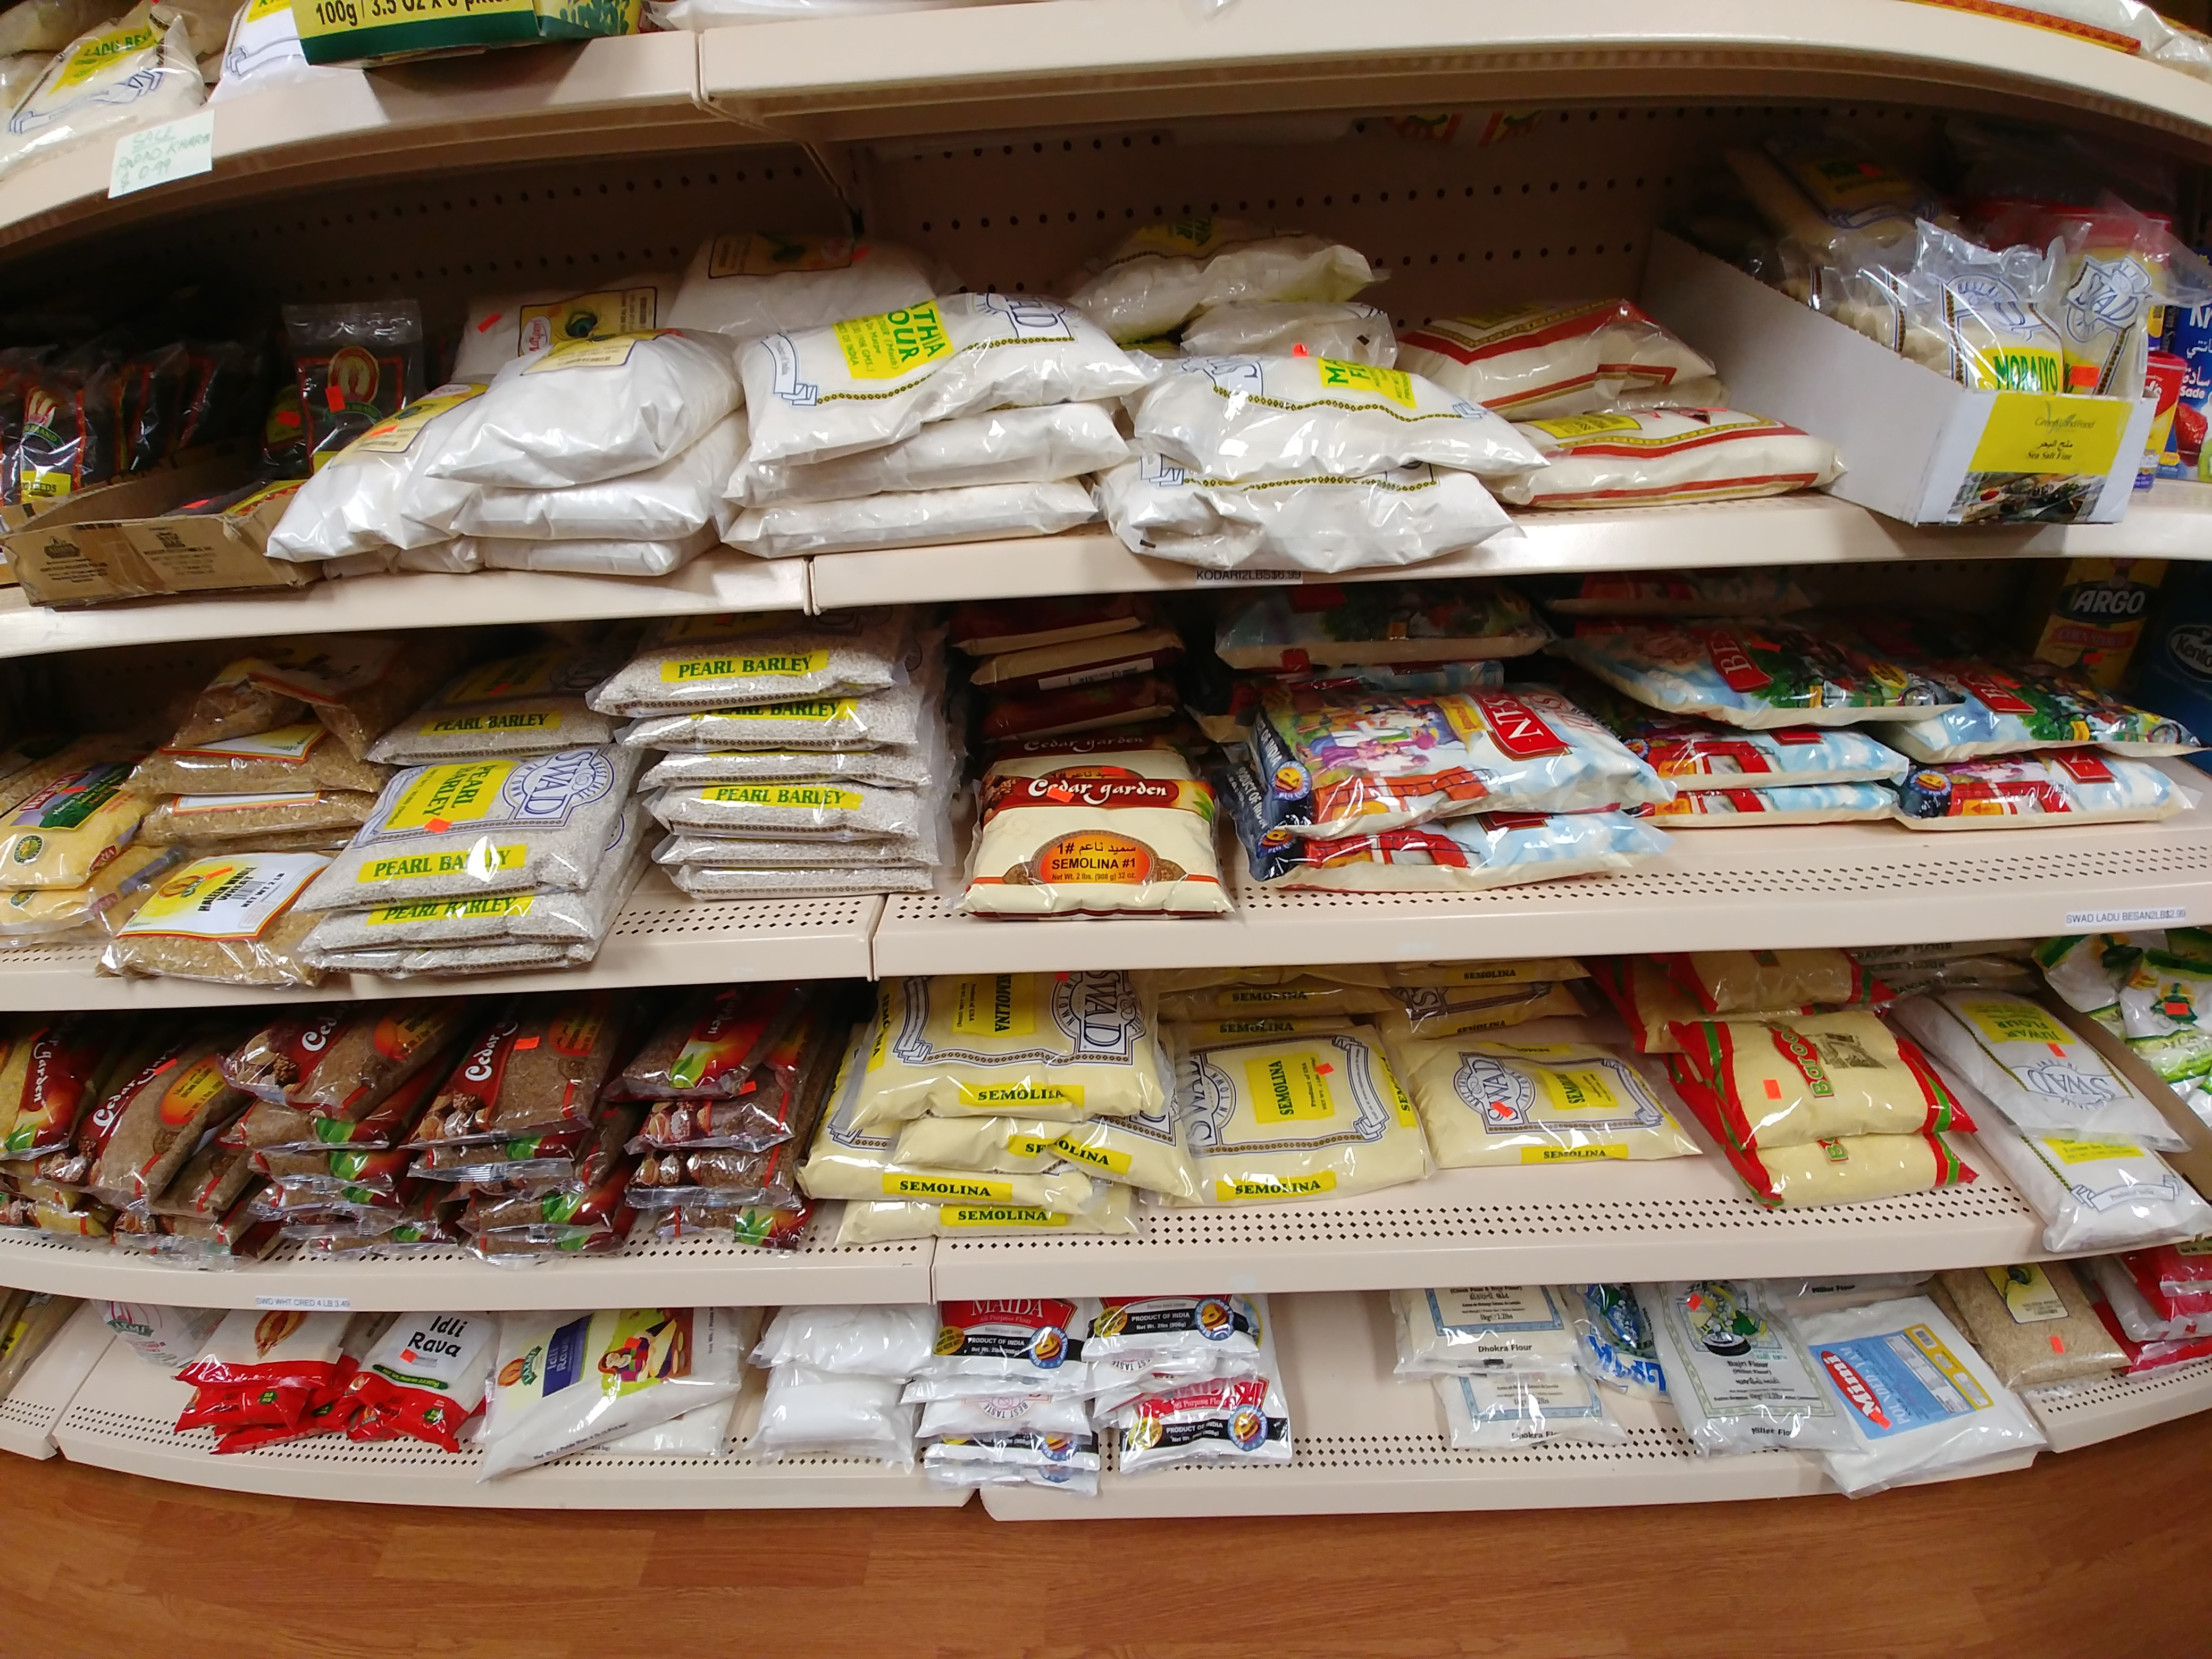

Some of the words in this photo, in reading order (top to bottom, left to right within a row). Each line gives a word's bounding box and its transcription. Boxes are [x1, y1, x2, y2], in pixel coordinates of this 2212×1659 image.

[910, 301, 945, 358] THIA
[2075, 589, 2146, 615] ARGO
[2178, 638, 2212, 669] Kento
[678, 660, 736, 678] PEARL
[742, 655, 814, 673] BARLEY
[433, 715, 483, 732] PEARL
[488, 713, 549, 730] BARLEY
[1264, 739, 1283, 767] INDIA
[592, 761, 607, 780] BEST
[423, 767, 469, 816] BARLEY
[451, 764, 499, 809] PEARL
[524, 751, 594, 815] SWAD
[715, 787, 773, 803] PEARL
[777, 789, 847, 805] BARLEY
[1083, 780, 1168, 806] garden
[373, 856, 433, 878] PEARL
[439, 849, 512, 873] BAY
[1051, 857, 1120, 870] SEMOLINA
[1122, 857, 1136, 869] #1
[382, 902, 439, 921] PEARL
[2066, 914, 2094, 924] SWAD
[2096, 912, 2120, 923] LADU
[1463, 969, 1516, 979] SEMOLINA
[995, 974, 1012, 1033] EMOLINA
[1231, 990, 1309, 1003] SEMOLINA
[1219, 1020, 1295, 1034] SEMOLINA
[1457, 1019, 1507, 1034] SEMOLINA
[464, 1033, 501, 1083] Cedar
[1779, 1026, 1834, 1097] Baroo
[1269, 1059, 1295, 1116] SEMOLINA
[2027, 1069, 2116, 1102] SWAD
[1053, 1138, 1110, 1167] OLINA
[1543, 1148, 1607, 1159] SEMOLINA
[899, 1180, 992, 1197] SEMOLINA
[1235, 1179, 1321, 1196] SEMOLINA
[957, 1209, 1049, 1221] SEMOLINA
[971, 1299, 1044, 1318] MAIDA
[1131, 1313, 1162, 1322] PRODUCT
[429, 1315, 469, 1338] Idli
[989, 1314, 1015, 1323] Purpose
[1015, 1316, 1033, 1325] Flour
[407, 1331, 462, 1358] Rava
[556, 1335, 571, 1373] Rava
[1478, 1345, 1509, 1353] Dhokra
[547, 1346, 560, 1372] Idli
[1727, 1360, 1747, 1369] Bajri
[983, 1403, 1006, 1419] TASTE
[1010, 1402, 1029, 1419] BEST
[1166, 1423, 1196, 1434] PRODUCT
[1206, 1421, 1224, 1429] INDIA
[1751, 1427, 1775, 1435] Millet
